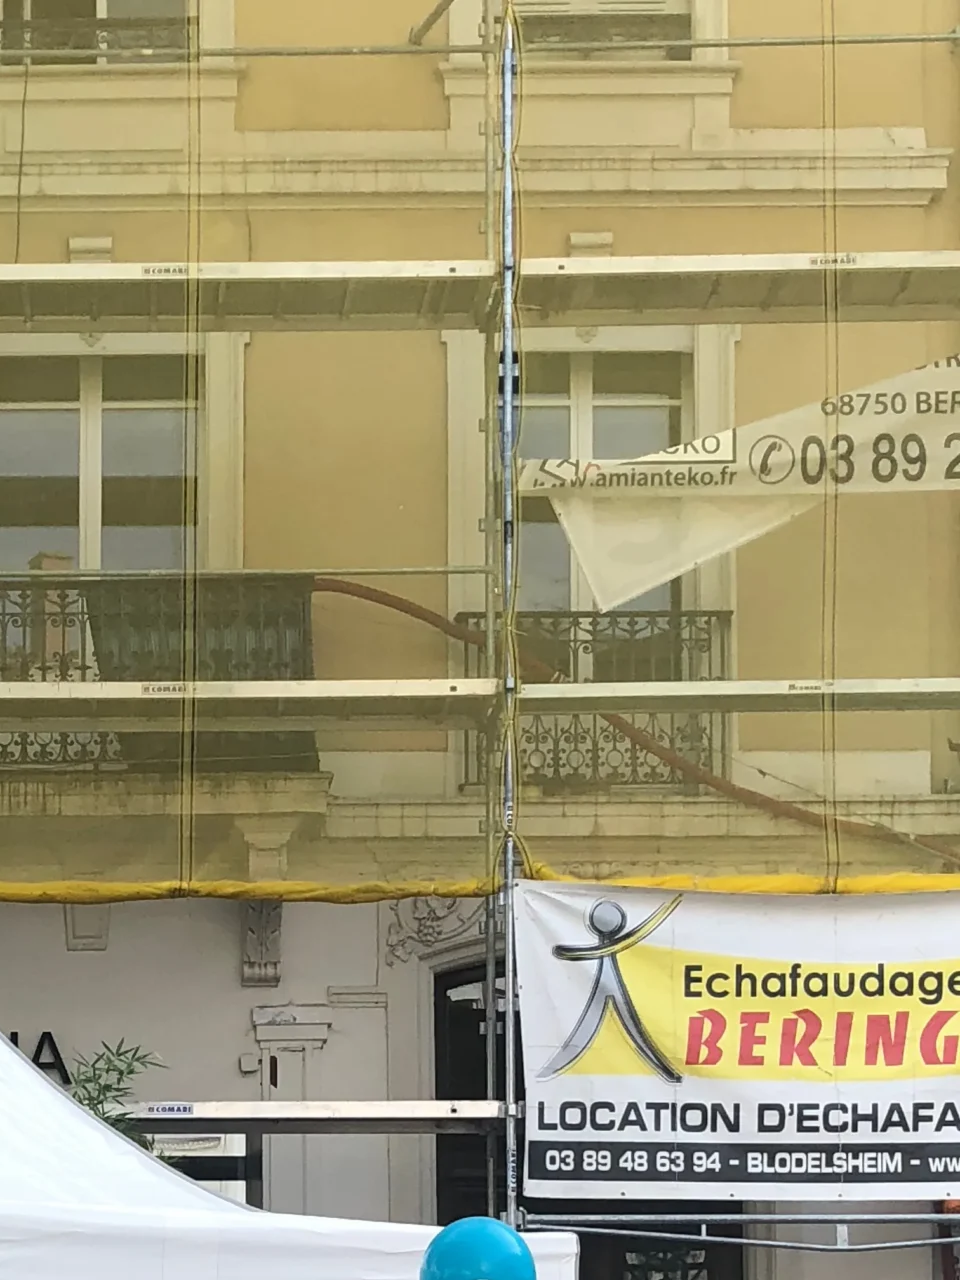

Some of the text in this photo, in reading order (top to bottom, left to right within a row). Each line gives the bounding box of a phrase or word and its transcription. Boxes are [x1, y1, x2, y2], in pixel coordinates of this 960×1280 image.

[820, 391, 907, 416] 68750
[800, 433, 855, 485] 03
[872, 432, 927, 483] 89
[684, 1008, 960, 1067] BERING
[536, 1101, 740, 1134] LOCATION
[545, 1150, 574, 1171] 03
[582, 1150, 611, 1172] 89
[619, 1150, 648, 1172] 48
[655, 1151, 685, 1172] 63
[692, 1151, 722, 1172] 94
[746, 1151, 903, 1174] BLODELSHEIM
